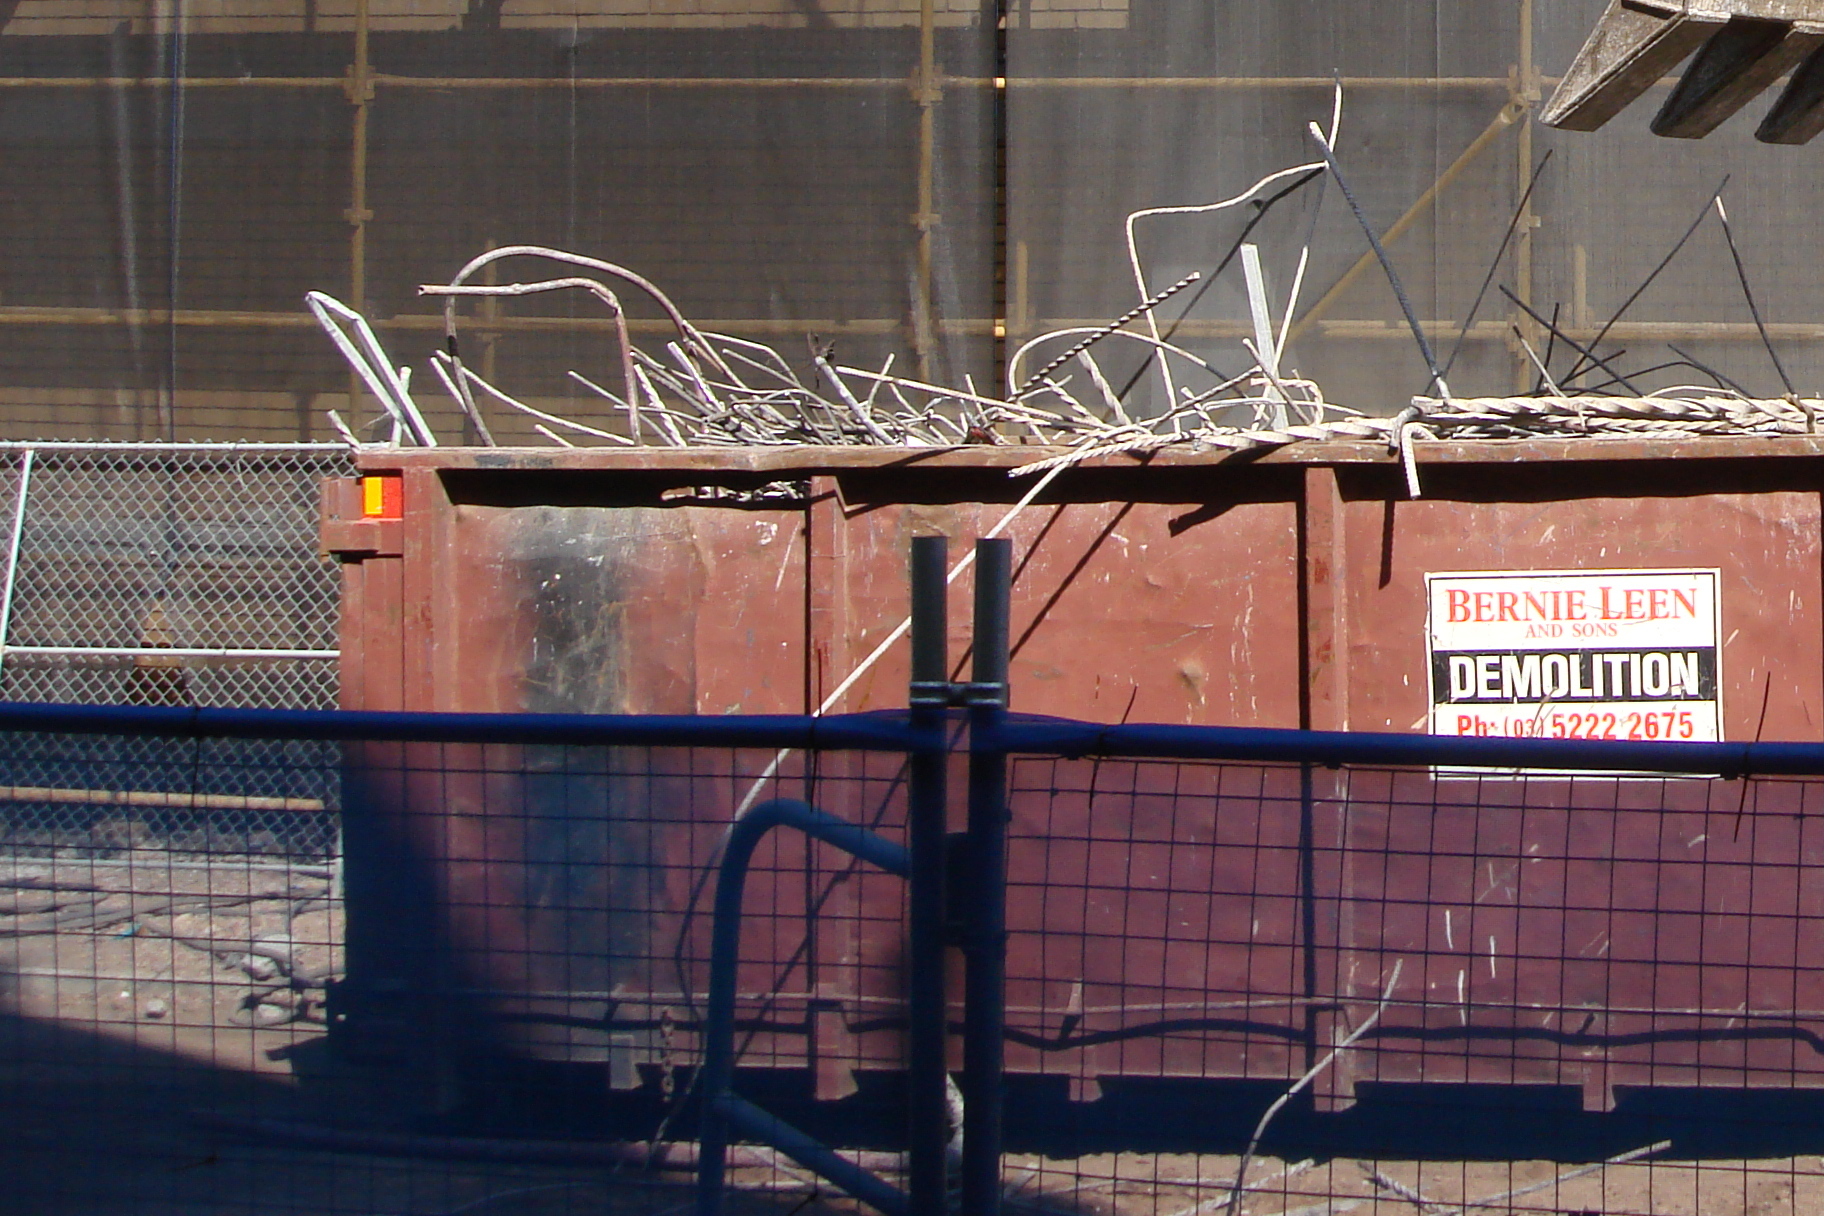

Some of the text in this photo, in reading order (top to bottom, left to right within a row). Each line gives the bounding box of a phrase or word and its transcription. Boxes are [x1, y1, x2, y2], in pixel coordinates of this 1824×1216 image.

[1445, 586, 1698, 623] BERNIE LEEN
[1525, 622, 1618, 639] AND SONS
[1448, 651, 1700, 700] DEMOLITION
[1551, 712, 1617, 741] 5222
[1628, 711, 1694, 741] 2675
